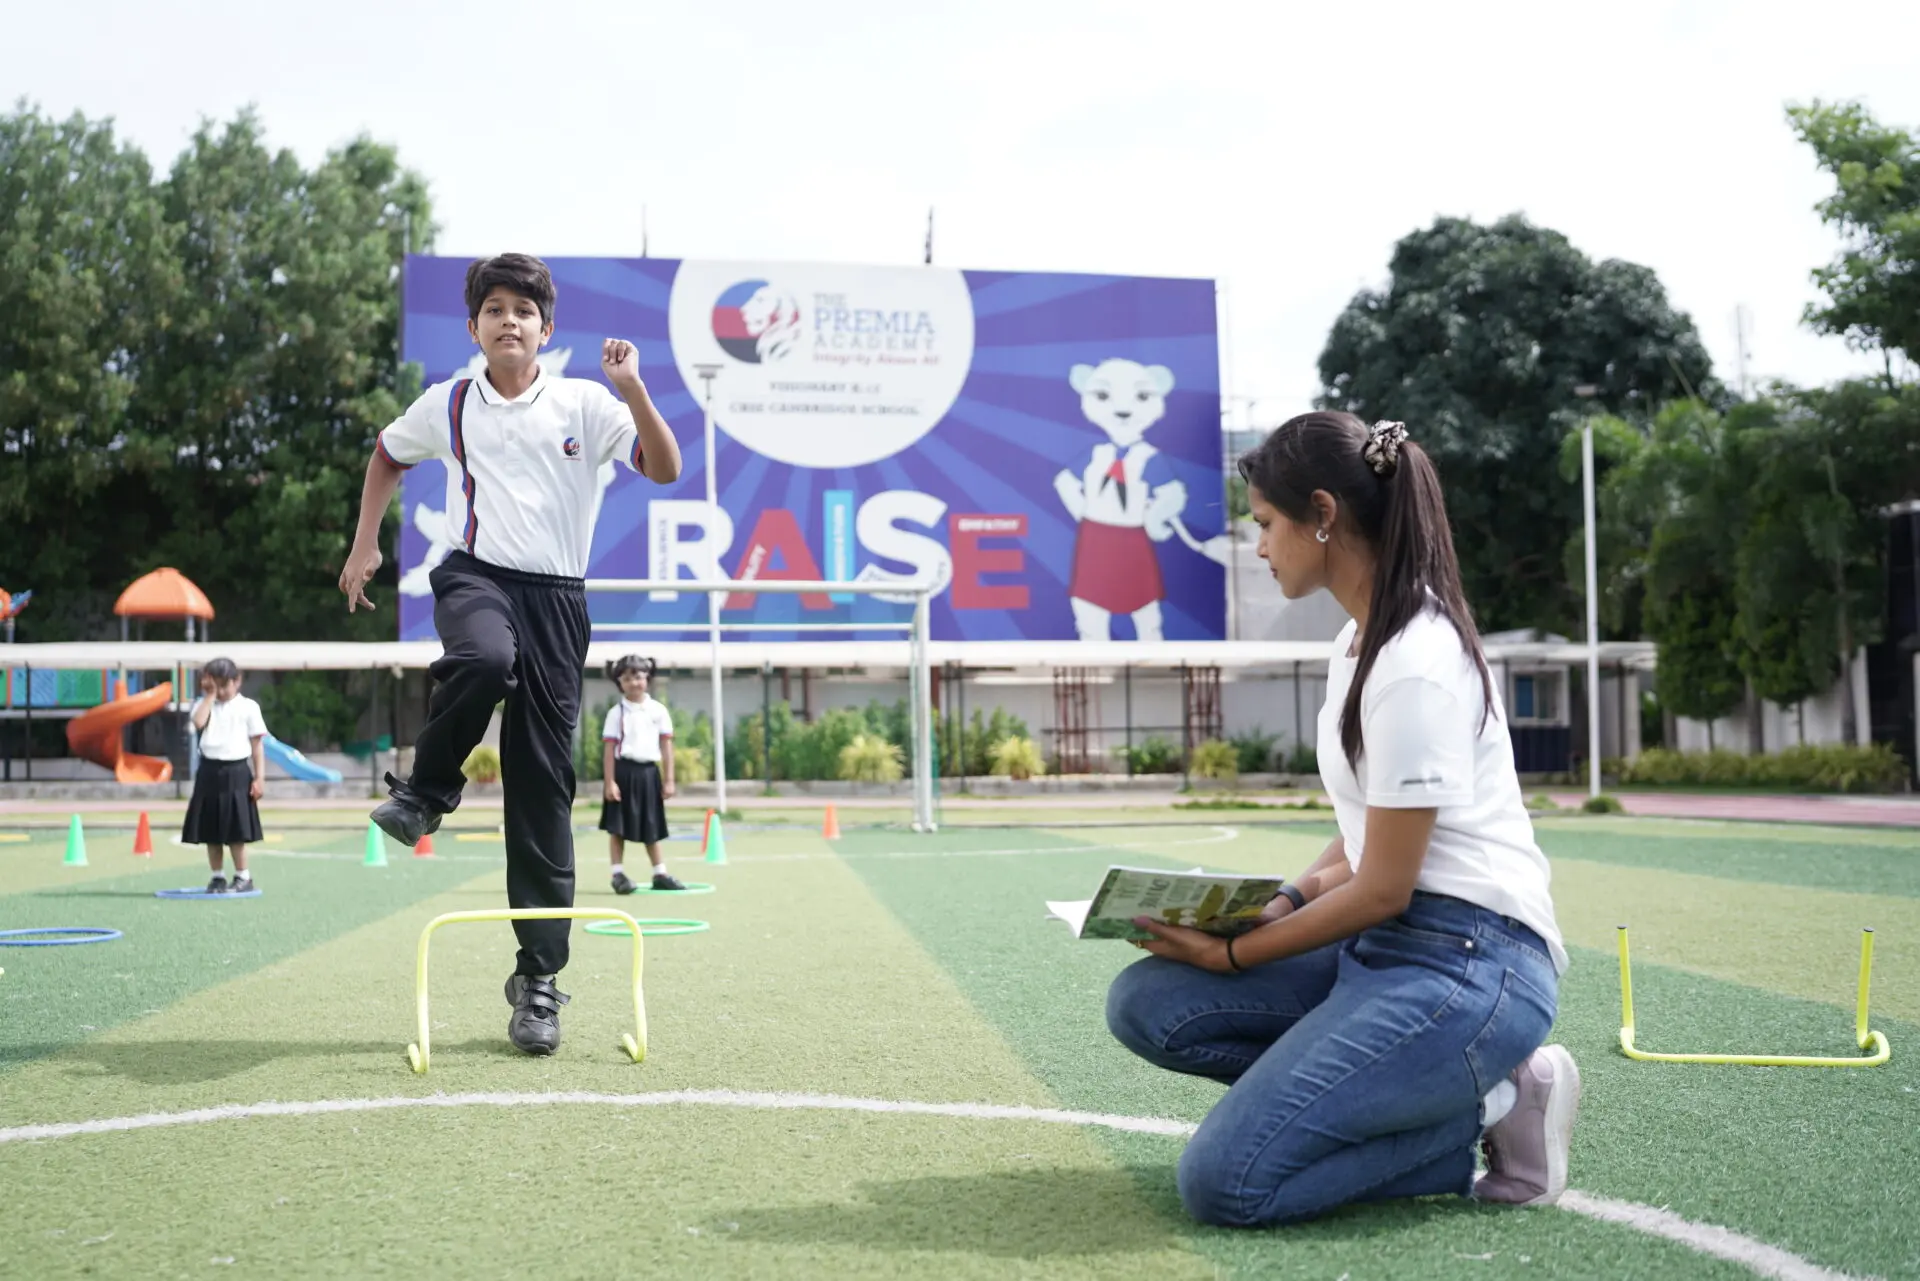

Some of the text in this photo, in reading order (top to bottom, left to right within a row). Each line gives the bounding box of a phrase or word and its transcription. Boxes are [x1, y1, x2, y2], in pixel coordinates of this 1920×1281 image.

[813, 308, 935, 335] PREMIA
[813, 334, 935, 351] ACADEMY
[648, 489, 1030, 610] RAISE
